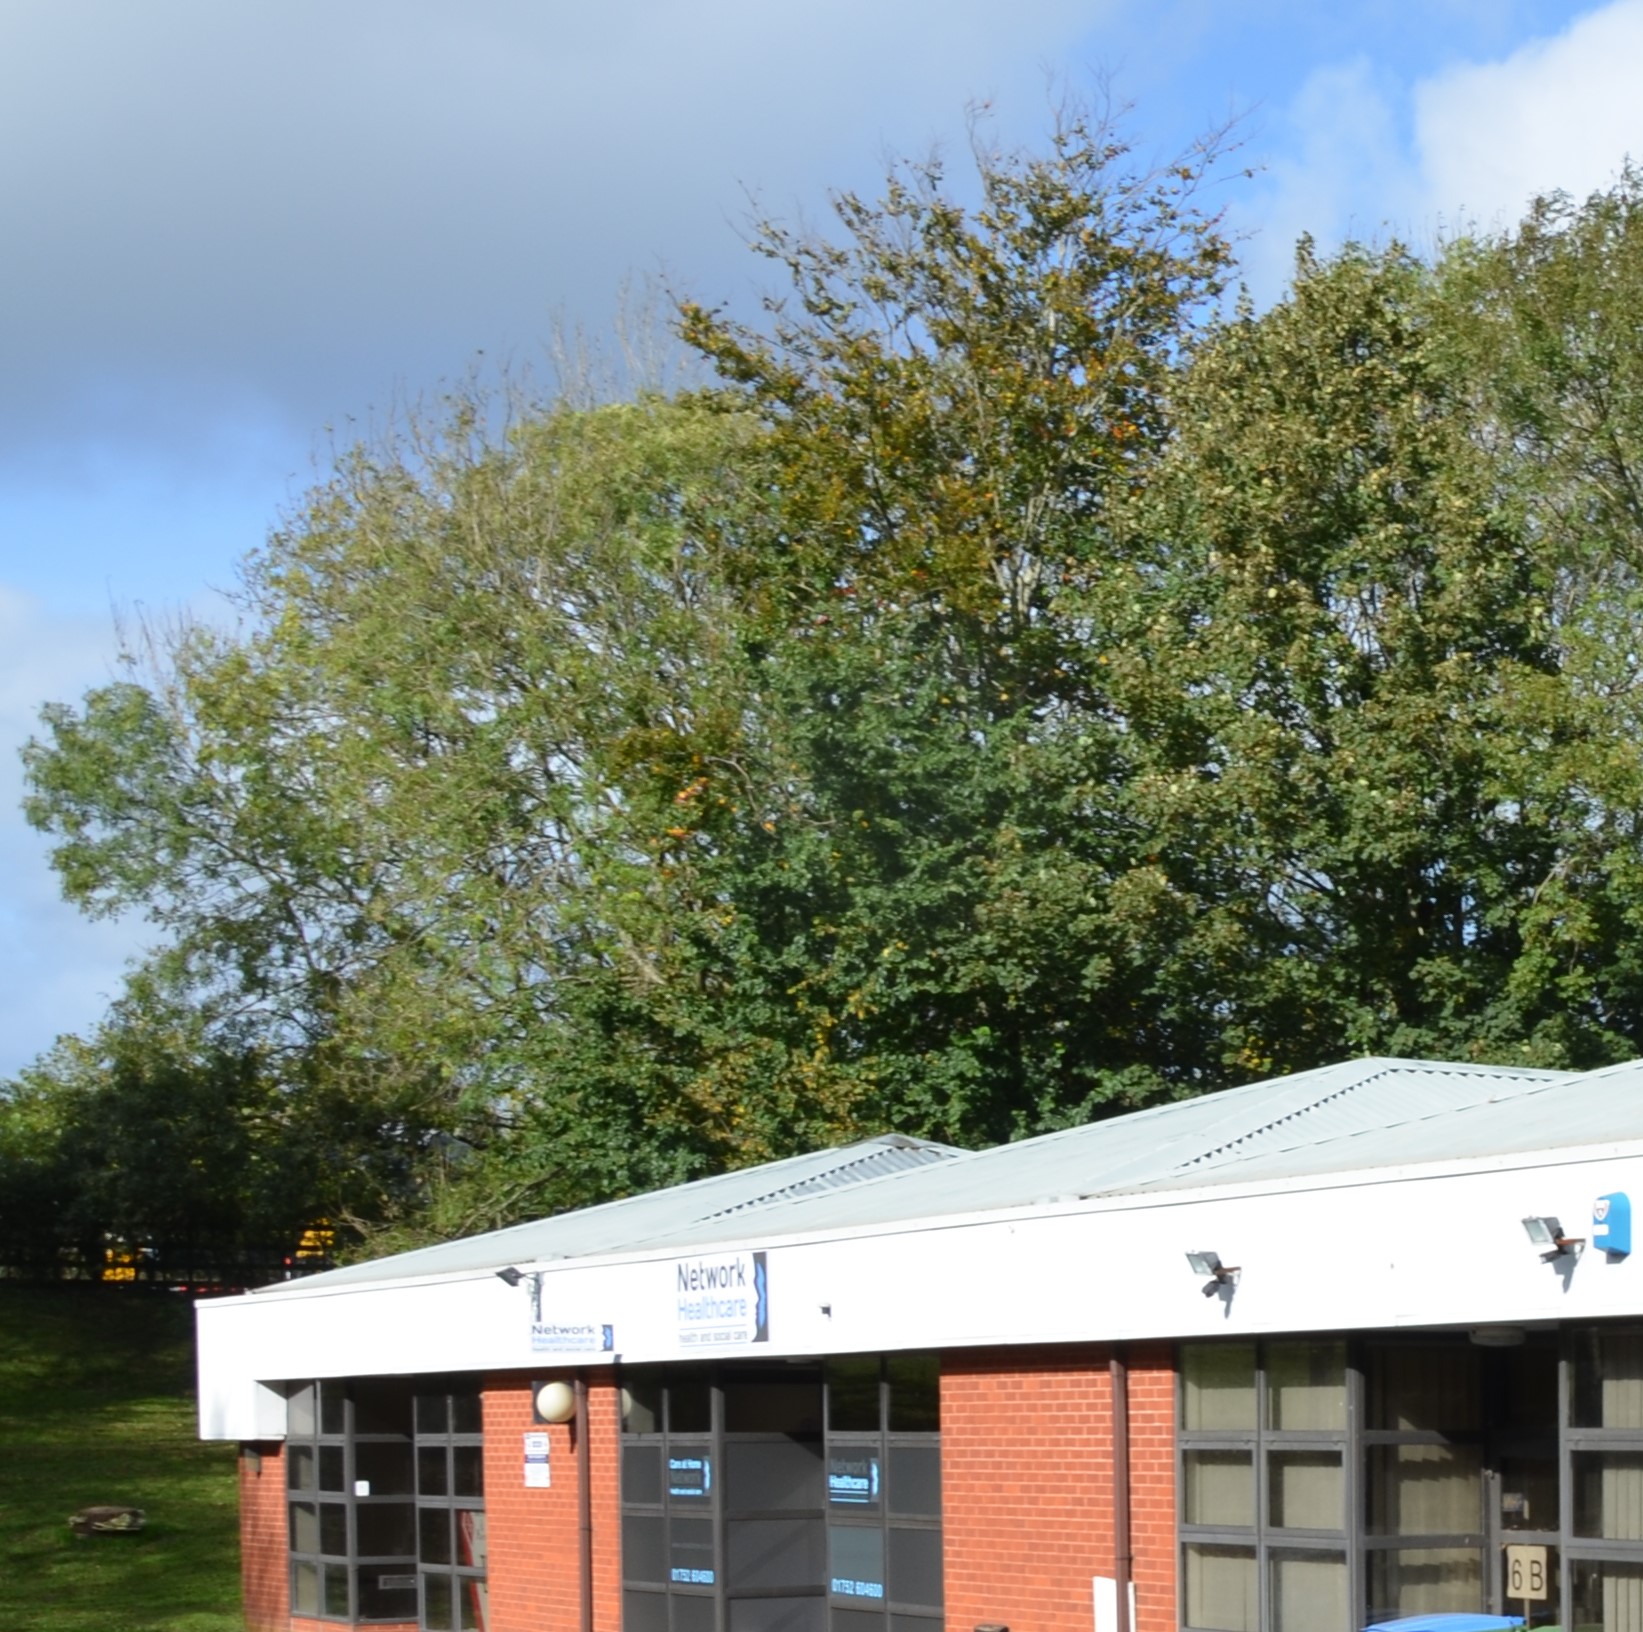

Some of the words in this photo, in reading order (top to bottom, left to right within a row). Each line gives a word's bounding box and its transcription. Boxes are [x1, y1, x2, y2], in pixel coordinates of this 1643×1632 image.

[677, 1257, 746, 1292] Network
[678, 1296, 747, 1321] Healthcare
[532, 1325, 595, 1335] Network
[829, 1458, 867, 1473] Network
[829, 1474, 869, 1489] Healthcare
[671, 1568, 691, 1582] 01752
[832, 1578, 854, 1595] 01752
